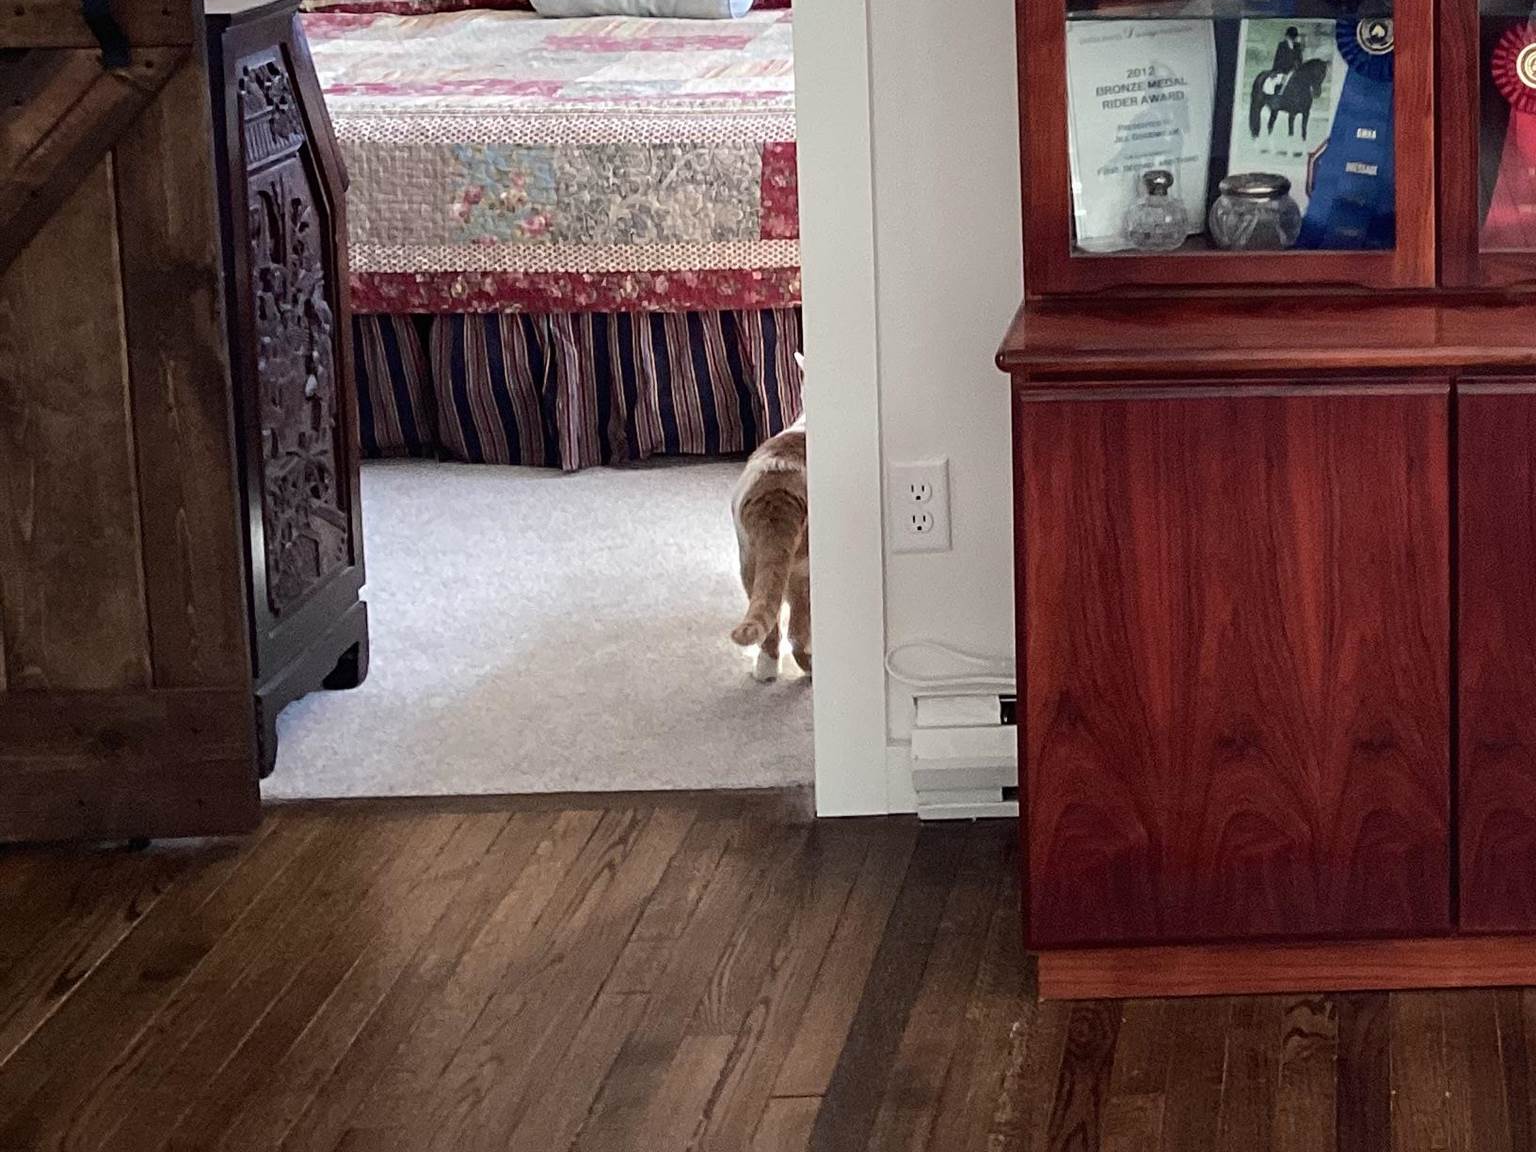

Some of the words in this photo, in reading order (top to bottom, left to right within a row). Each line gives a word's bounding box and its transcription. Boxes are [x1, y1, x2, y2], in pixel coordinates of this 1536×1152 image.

[1096, 81, 1145, 97] BRONZE
[1147, 76, 1188, 89] MEDAL
[1102, 95, 1138, 110] RIDER
[1141, 90, 1185, 105] AWARD
